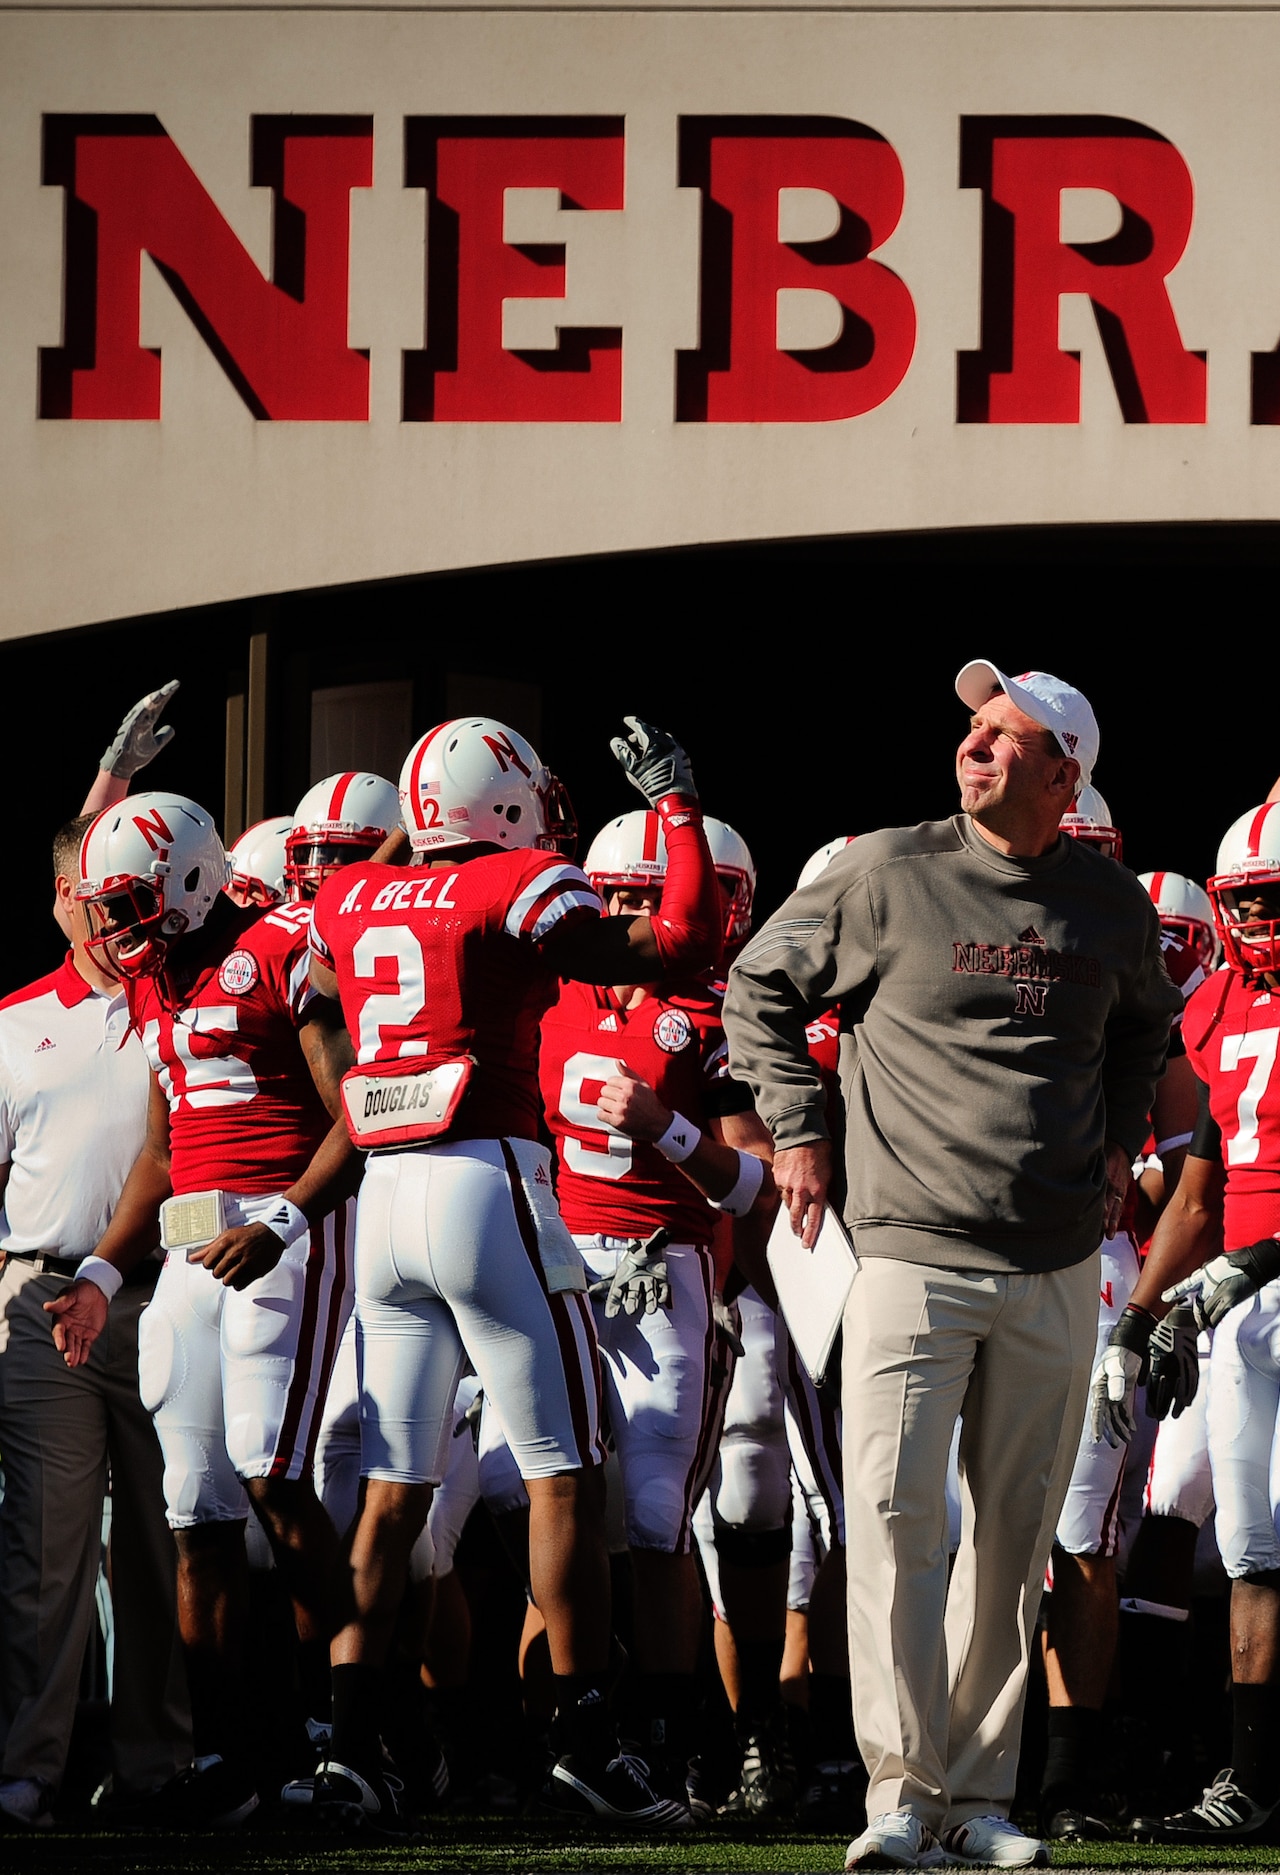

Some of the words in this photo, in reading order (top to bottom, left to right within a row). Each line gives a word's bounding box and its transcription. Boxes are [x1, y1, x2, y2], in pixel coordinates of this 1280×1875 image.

[481, 732, 532, 779] N
[132, 808, 175, 852] N
[423, 798, 444, 829] 2
[338, 878, 368, 915] A.
[371, 873, 459, 911] BELL
[952, 941, 1101, 988] NEBRASKA
[353, 925, 429, 1066] 2
[1015, 983, 1048, 1017] N
[142, 1005, 260, 1114] 15
[364, 1081, 433, 1118] DOUGLAS
[1219, 1026, 1280, 1166] 7
